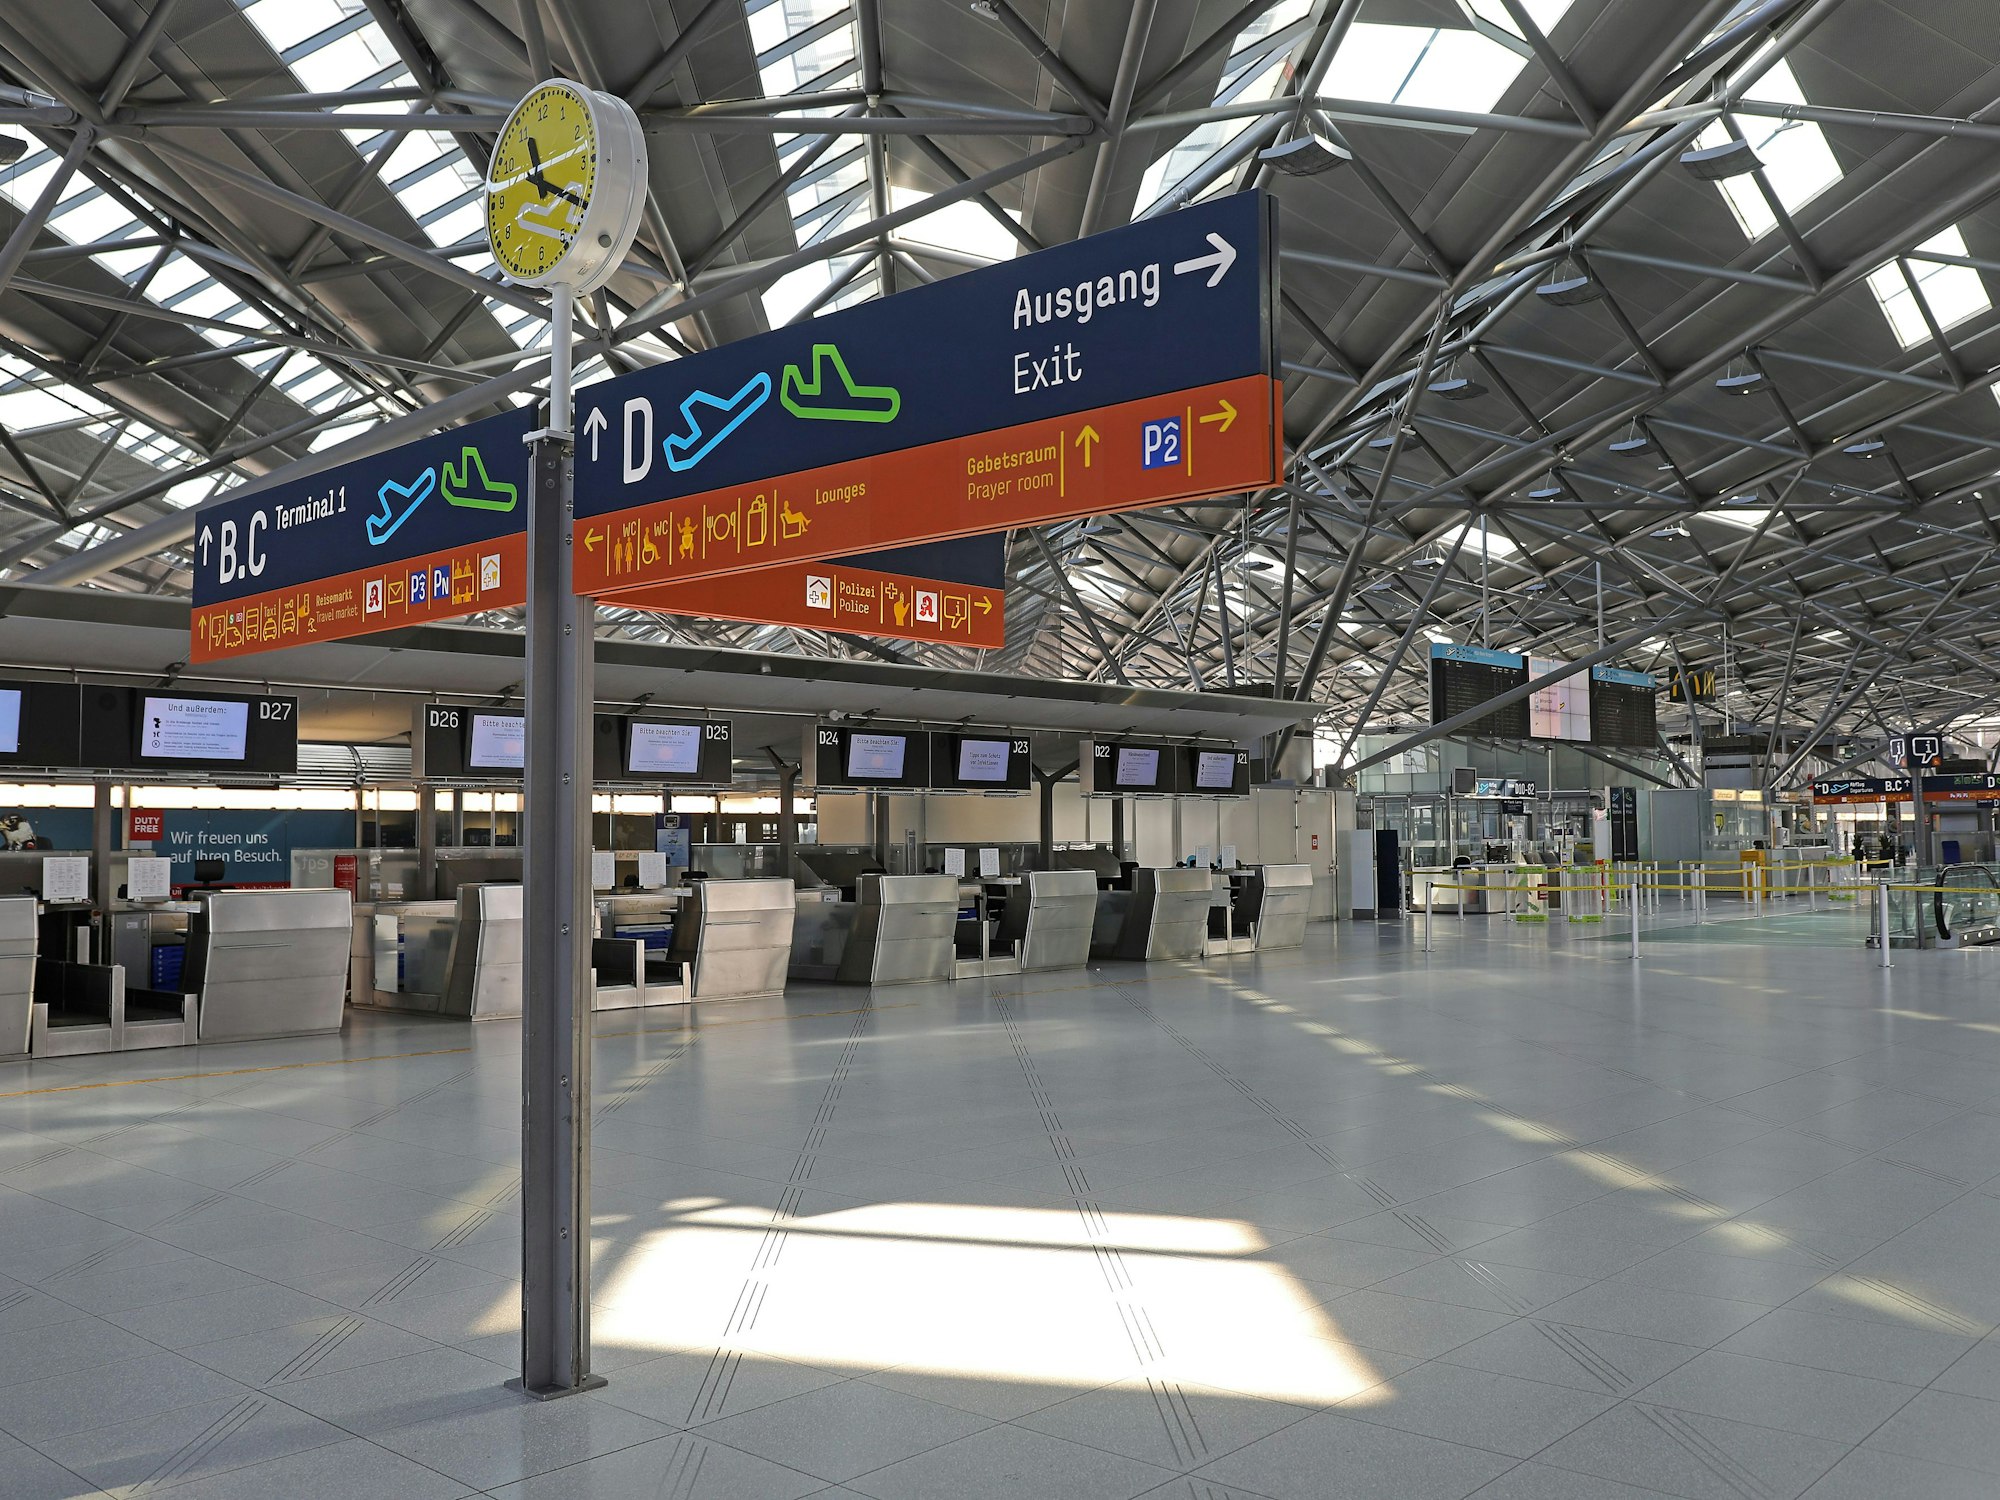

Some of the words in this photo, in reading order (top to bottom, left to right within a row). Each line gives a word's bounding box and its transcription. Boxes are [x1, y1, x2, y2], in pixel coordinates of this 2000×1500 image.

[537, 105, 548, 122] 12
[560, 107, 565, 121] 1
[518, 126, 529, 143] 11
[574, 125, 581, 141] 2
[504, 157, 514, 175] 10
[581, 155, 587, 170] 3
[499, 196, 505, 210] 9
[505, 225, 511, 239] 8
[539, 246, 544, 261] 6
[1013, 262, 1160, 330] Ausgang
[1014, 343, 1083, 395] Exit
[622, 396, 653, 484] D
[967, 444, 1057, 476] Gebetsraum
[815, 482, 866, 506] Lounges
[968, 479, 1012, 501] Prayer
[1017, 472, 1054, 492] room
[275, 494, 336, 530] Terminal
[338, 485, 347, 513] 1
[622, 520, 637, 538] WC
[653, 519, 669, 537] WC
[219, 510, 267, 584] B.C
[315, 587, 353, 607] Reisemarkt
[839, 581, 876, 598] Polizei
[264, 603, 277, 618] Taxi
[316, 607, 335, 624] Travel
[336, 604, 358, 620] market
[839, 598, 870, 614] Police
[168, 703, 183, 712] Und
[185, 704, 227, 714] außerdem:
[260, 701, 292, 721] D27
[430, 710, 459, 728] D26
[482, 719, 499, 728] Bitte
[639, 727, 654, 735] Bitte
[656, 728, 680, 736] beachten
[706, 724, 729, 740] D25
[819, 730, 839, 745] D24
[1095, 745, 1110, 758] D22
[1822, 783, 1829, 794] D
[1987, 776, 1996, 788] D
[134, 816, 160, 825] DUTY
[134, 824, 159, 833] FREE
[170, 831, 193, 845] Wir
[198, 830, 241, 845] freuen
[246, 832, 268, 844] uns
[170, 850, 192, 864] auf
[235, 848, 282, 863] Besuch.
